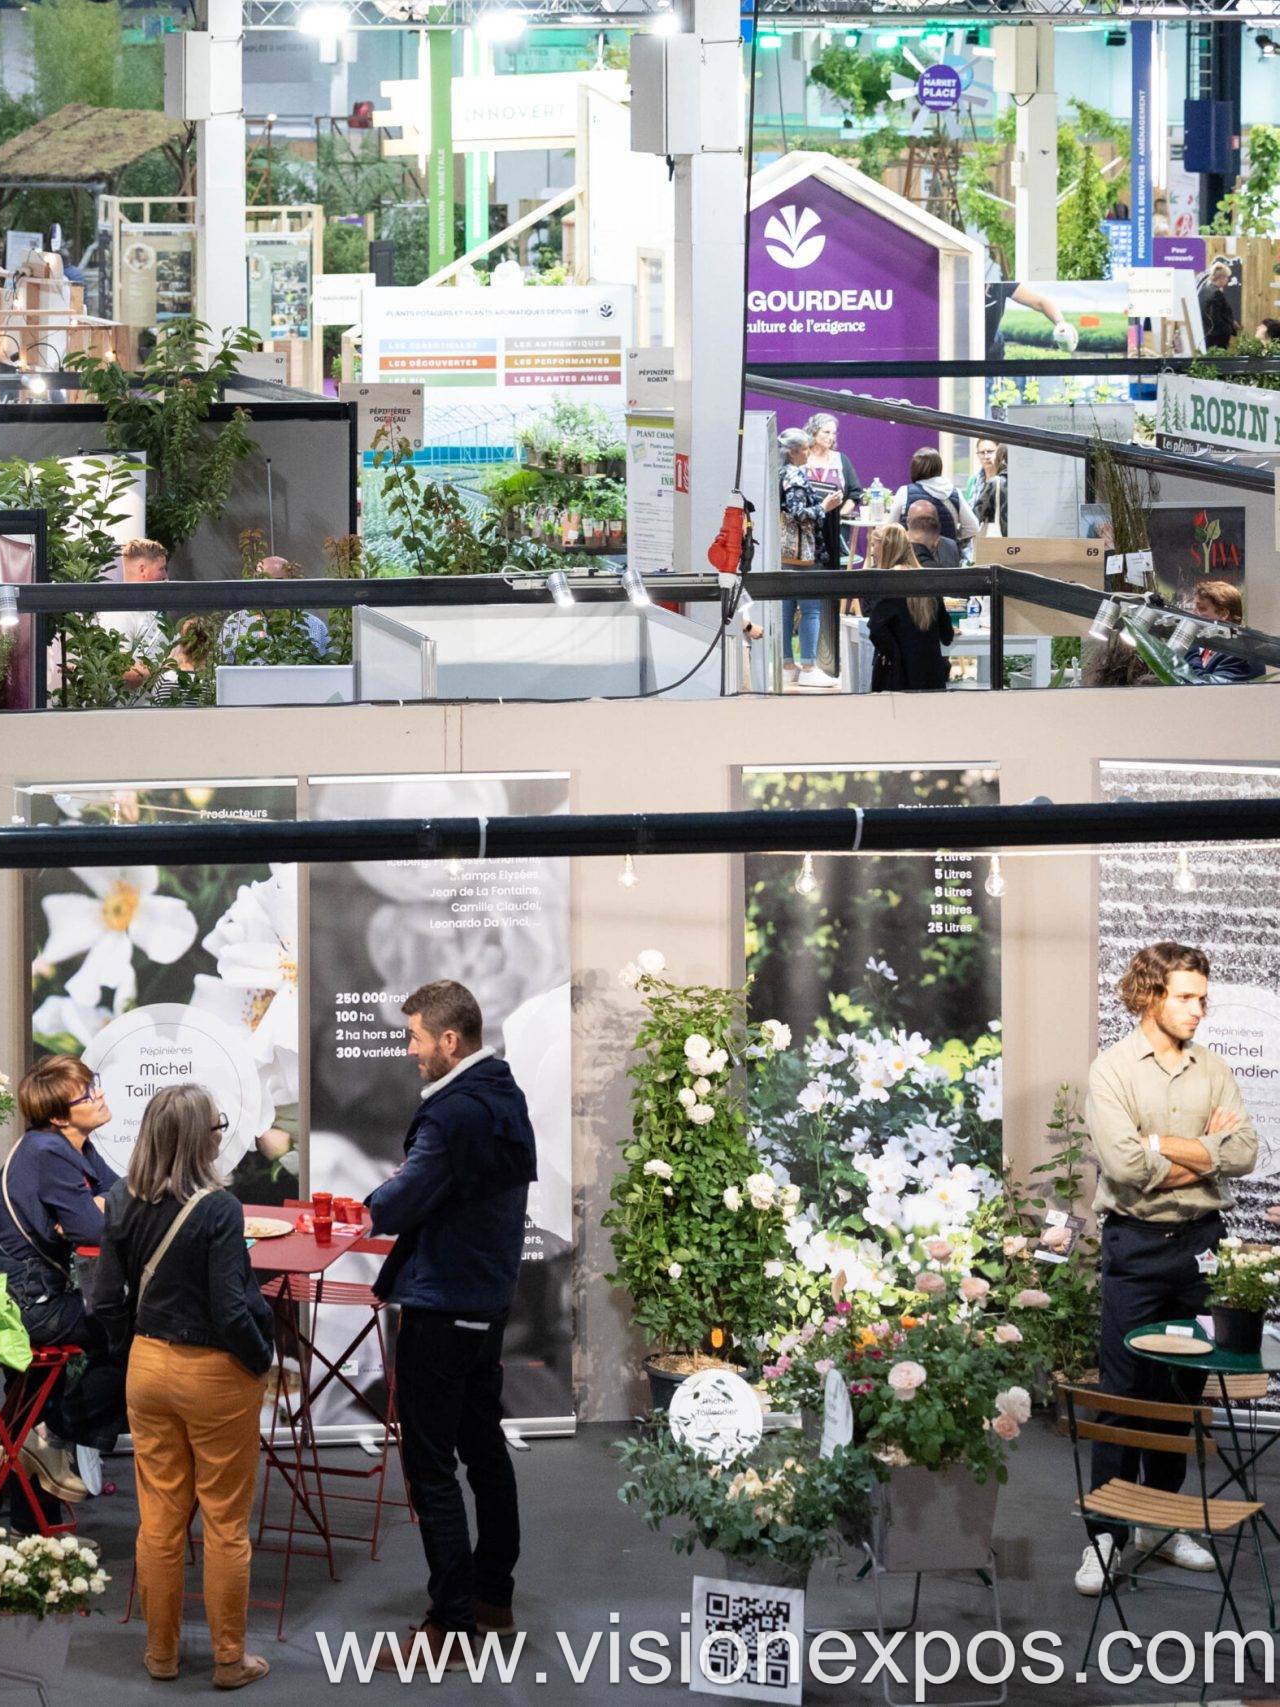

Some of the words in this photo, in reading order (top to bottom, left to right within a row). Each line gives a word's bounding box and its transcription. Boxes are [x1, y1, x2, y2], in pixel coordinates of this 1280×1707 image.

[923, 78, 957, 87] MARKET
[922, 87, 957, 98] PLACE
[1137, 90, 1146, 156] AMÉNAGEMENT
[1138, 164, 1146, 205] SERVICES
[438, 200, 446, 255] INNOVATION
[1138, 216, 1146, 259] PRODUITS
[747, 289, 893, 313] GOURDEAU
[788, 319, 804, 333] de
[806, 318, 866, 335] l'exigence
[513, 340, 532, 349] LES
[534, 339, 606, 348] AUTHENTIQUES
[408, 358, 478, 367] DÉCOUVERTES
[513, 358, 532, 366] LES
[534, 357, 609, 366] PERFORMANTES
[534, 375, 578, 383] PLANTES
[580, 374, 609, 382] AMIES
[1190, 394, 1269, 443] ROBIN
[636, 430, 656, 438] PLANT
[1006, 547, 1021, 556] GP
[1086, 548, 1099, 557] 69
[199, 808, 268, 820] Producteurs
[934, 868, 943, 879] 5
[944, 869, 972, 879] Litres
[429, 887, 455, 898] Jean
[458, 886, 473, 897] de
[476, 886, 488, 896] La
[491, 885, 542, 897] Fontaine,
[934, 886, 943, 897] 8
[944, 887, 972, 897] Litres
[451, 902, 493, 913] Camille
[496, 901, 542, 913] Claudel,
[929, 904, 943, 915] 13
[944, 904, 972, 915] Litres
[429, 918, 480, 929] Leonardo
[501, 917, 529, 929] Vinci,
[927, 922, 943, 933] 25
[944, 922, 972, 933] Litres
[335, 993, 360, 1004] 250
[362, 992, 387, 1003] 000
[389, 992, 409, 1003] rosi
[335, 1011, 358, 1022] 100
[359, 1011, 375, 1022] ha
[335, 1029, 344, 1040] 2
[345, 1029, 361, 1040] ha
[362, 1029, 387, 1040] hors
[389, 1028, 406, 1039] sol
[140, 1046, 193, 1058] Pépinières
[335, 1047, 361, 1058] 300
[362, 1046, 407, 1058] variétés
[1208, 1042, 1263, 1057] Michel
[139, 1061, 192, 1076] Michel
